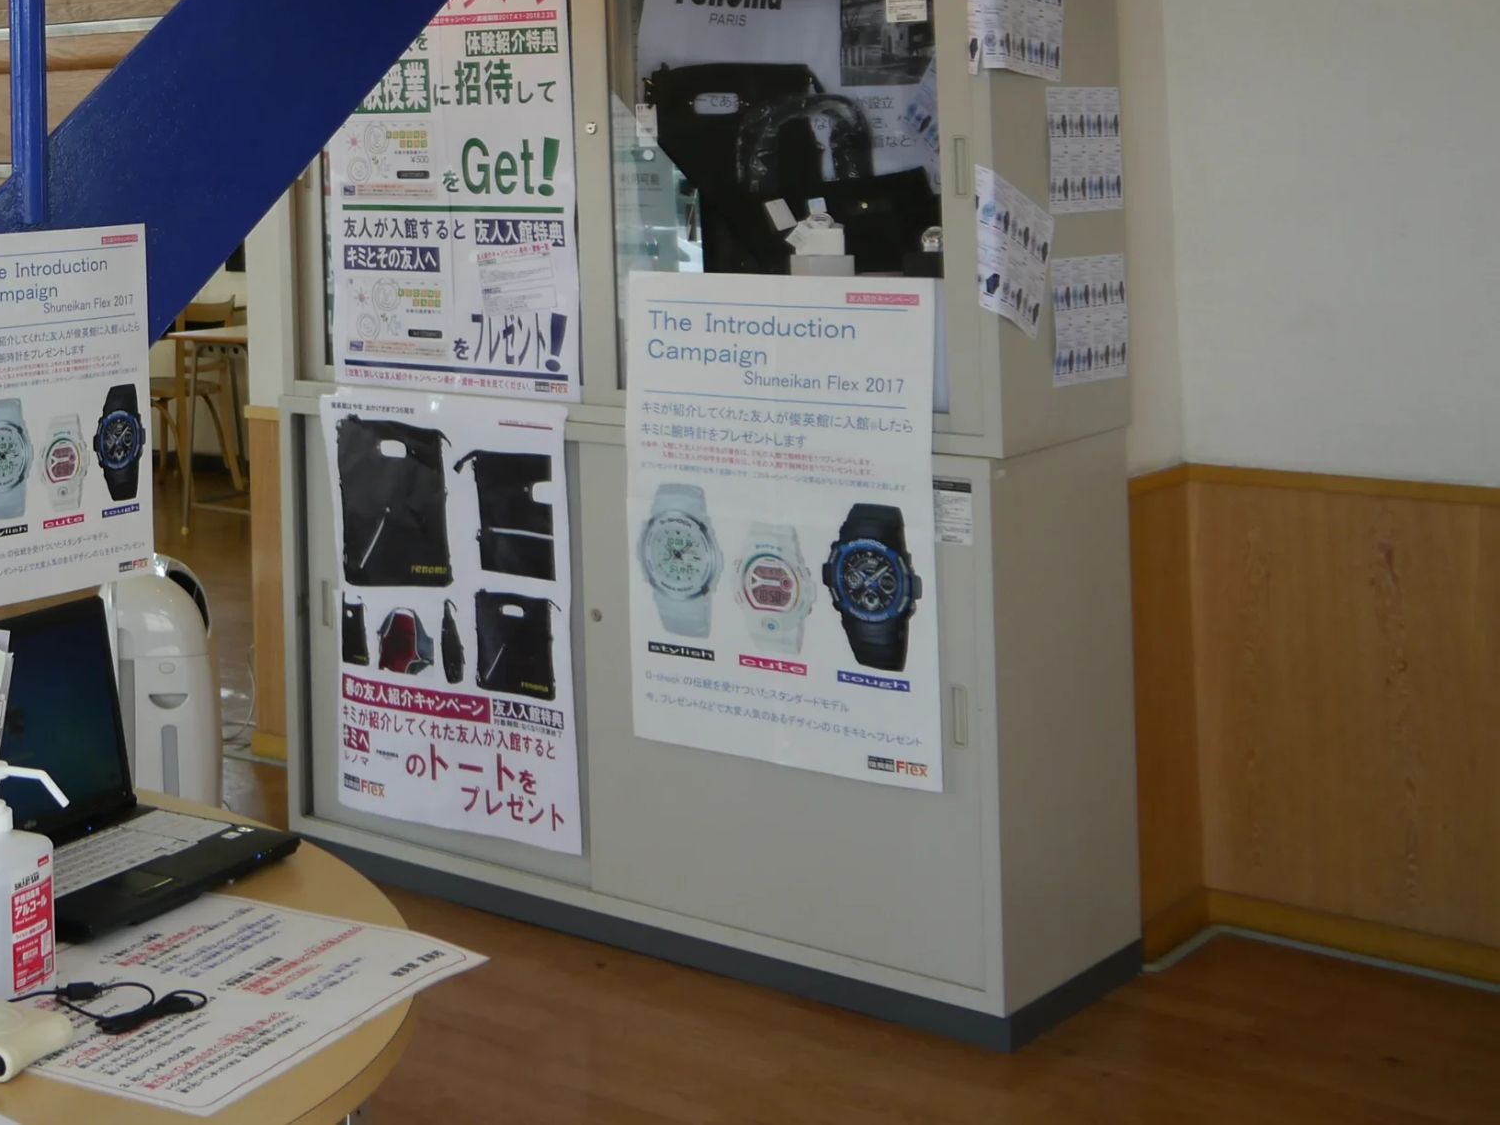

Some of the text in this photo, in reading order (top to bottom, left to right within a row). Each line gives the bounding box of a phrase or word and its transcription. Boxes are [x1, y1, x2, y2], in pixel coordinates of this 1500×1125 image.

[708, 12, 747, 26] PARIS
[466, 28, 557, 55] 体験紹介特典
[344, 217, 565, 245] 友人が入館すると 友人入館特典
[15, 256, 108, 279] Introduction
[346, 247, 438, 271] キミとその友人へ
[43, 294, 133, 314] Shuneikan Flex 2017
[648, 310, 856, 340] The Introduction
[647, 339, 768, 368] Campaign
[744, 371, 904, 394] Shuneikan Flex 2017
[650, 643, 713, 660] stylish
[740, 656, 805, 675] cute
[838, 671, 909, 691] tough
[344, 677, 484, 717] 春の友人紹介キャンペーン
[493, 699, 564, 729] 友人入館特典
[343, 705, 556, 760] キミが紹介してくれた友人が入館すると
[406, 743, 537, 795] のトートを
[895, 760, 928, 777] Flex
[361, 779, 385, 797] Flex
[461, 786, 565, 832] プレゼント
[14, 895, 48, 919] アルコール
